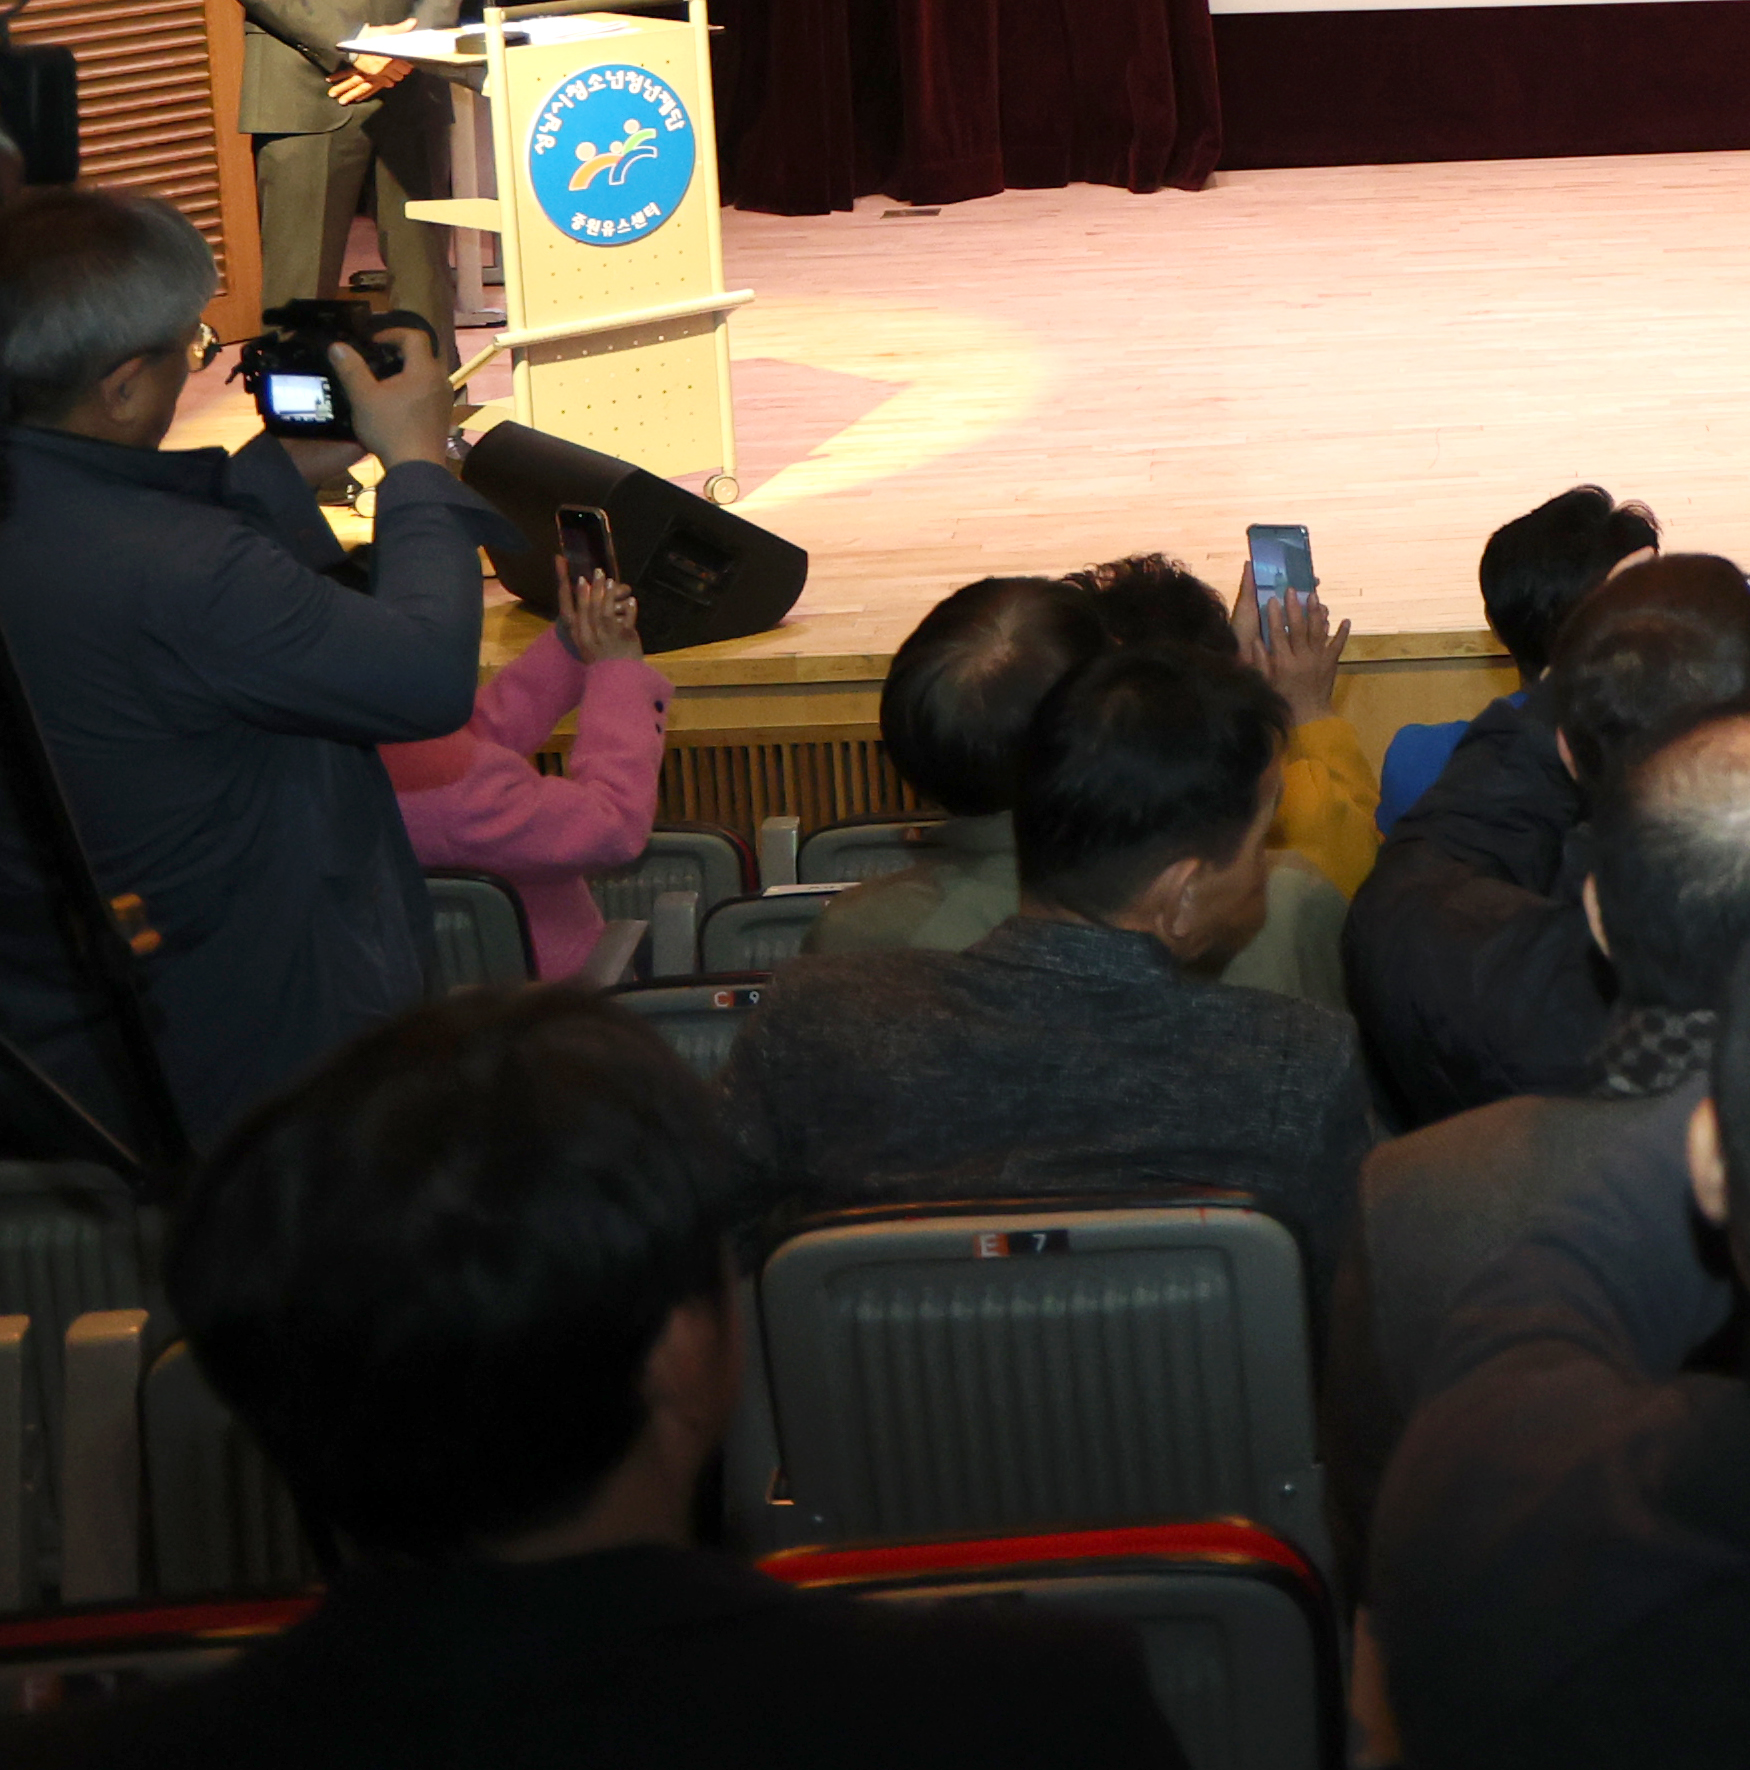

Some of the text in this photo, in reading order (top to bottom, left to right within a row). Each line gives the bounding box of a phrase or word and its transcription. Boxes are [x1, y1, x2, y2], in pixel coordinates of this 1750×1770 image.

[533, 69, 686, 156] 성남시청소년청년재단
[569, 200, 663, 238] 중원유스센터
[714, 990, 760, 1007] C 9
[980, 1233, 1047, 1258] E 7
